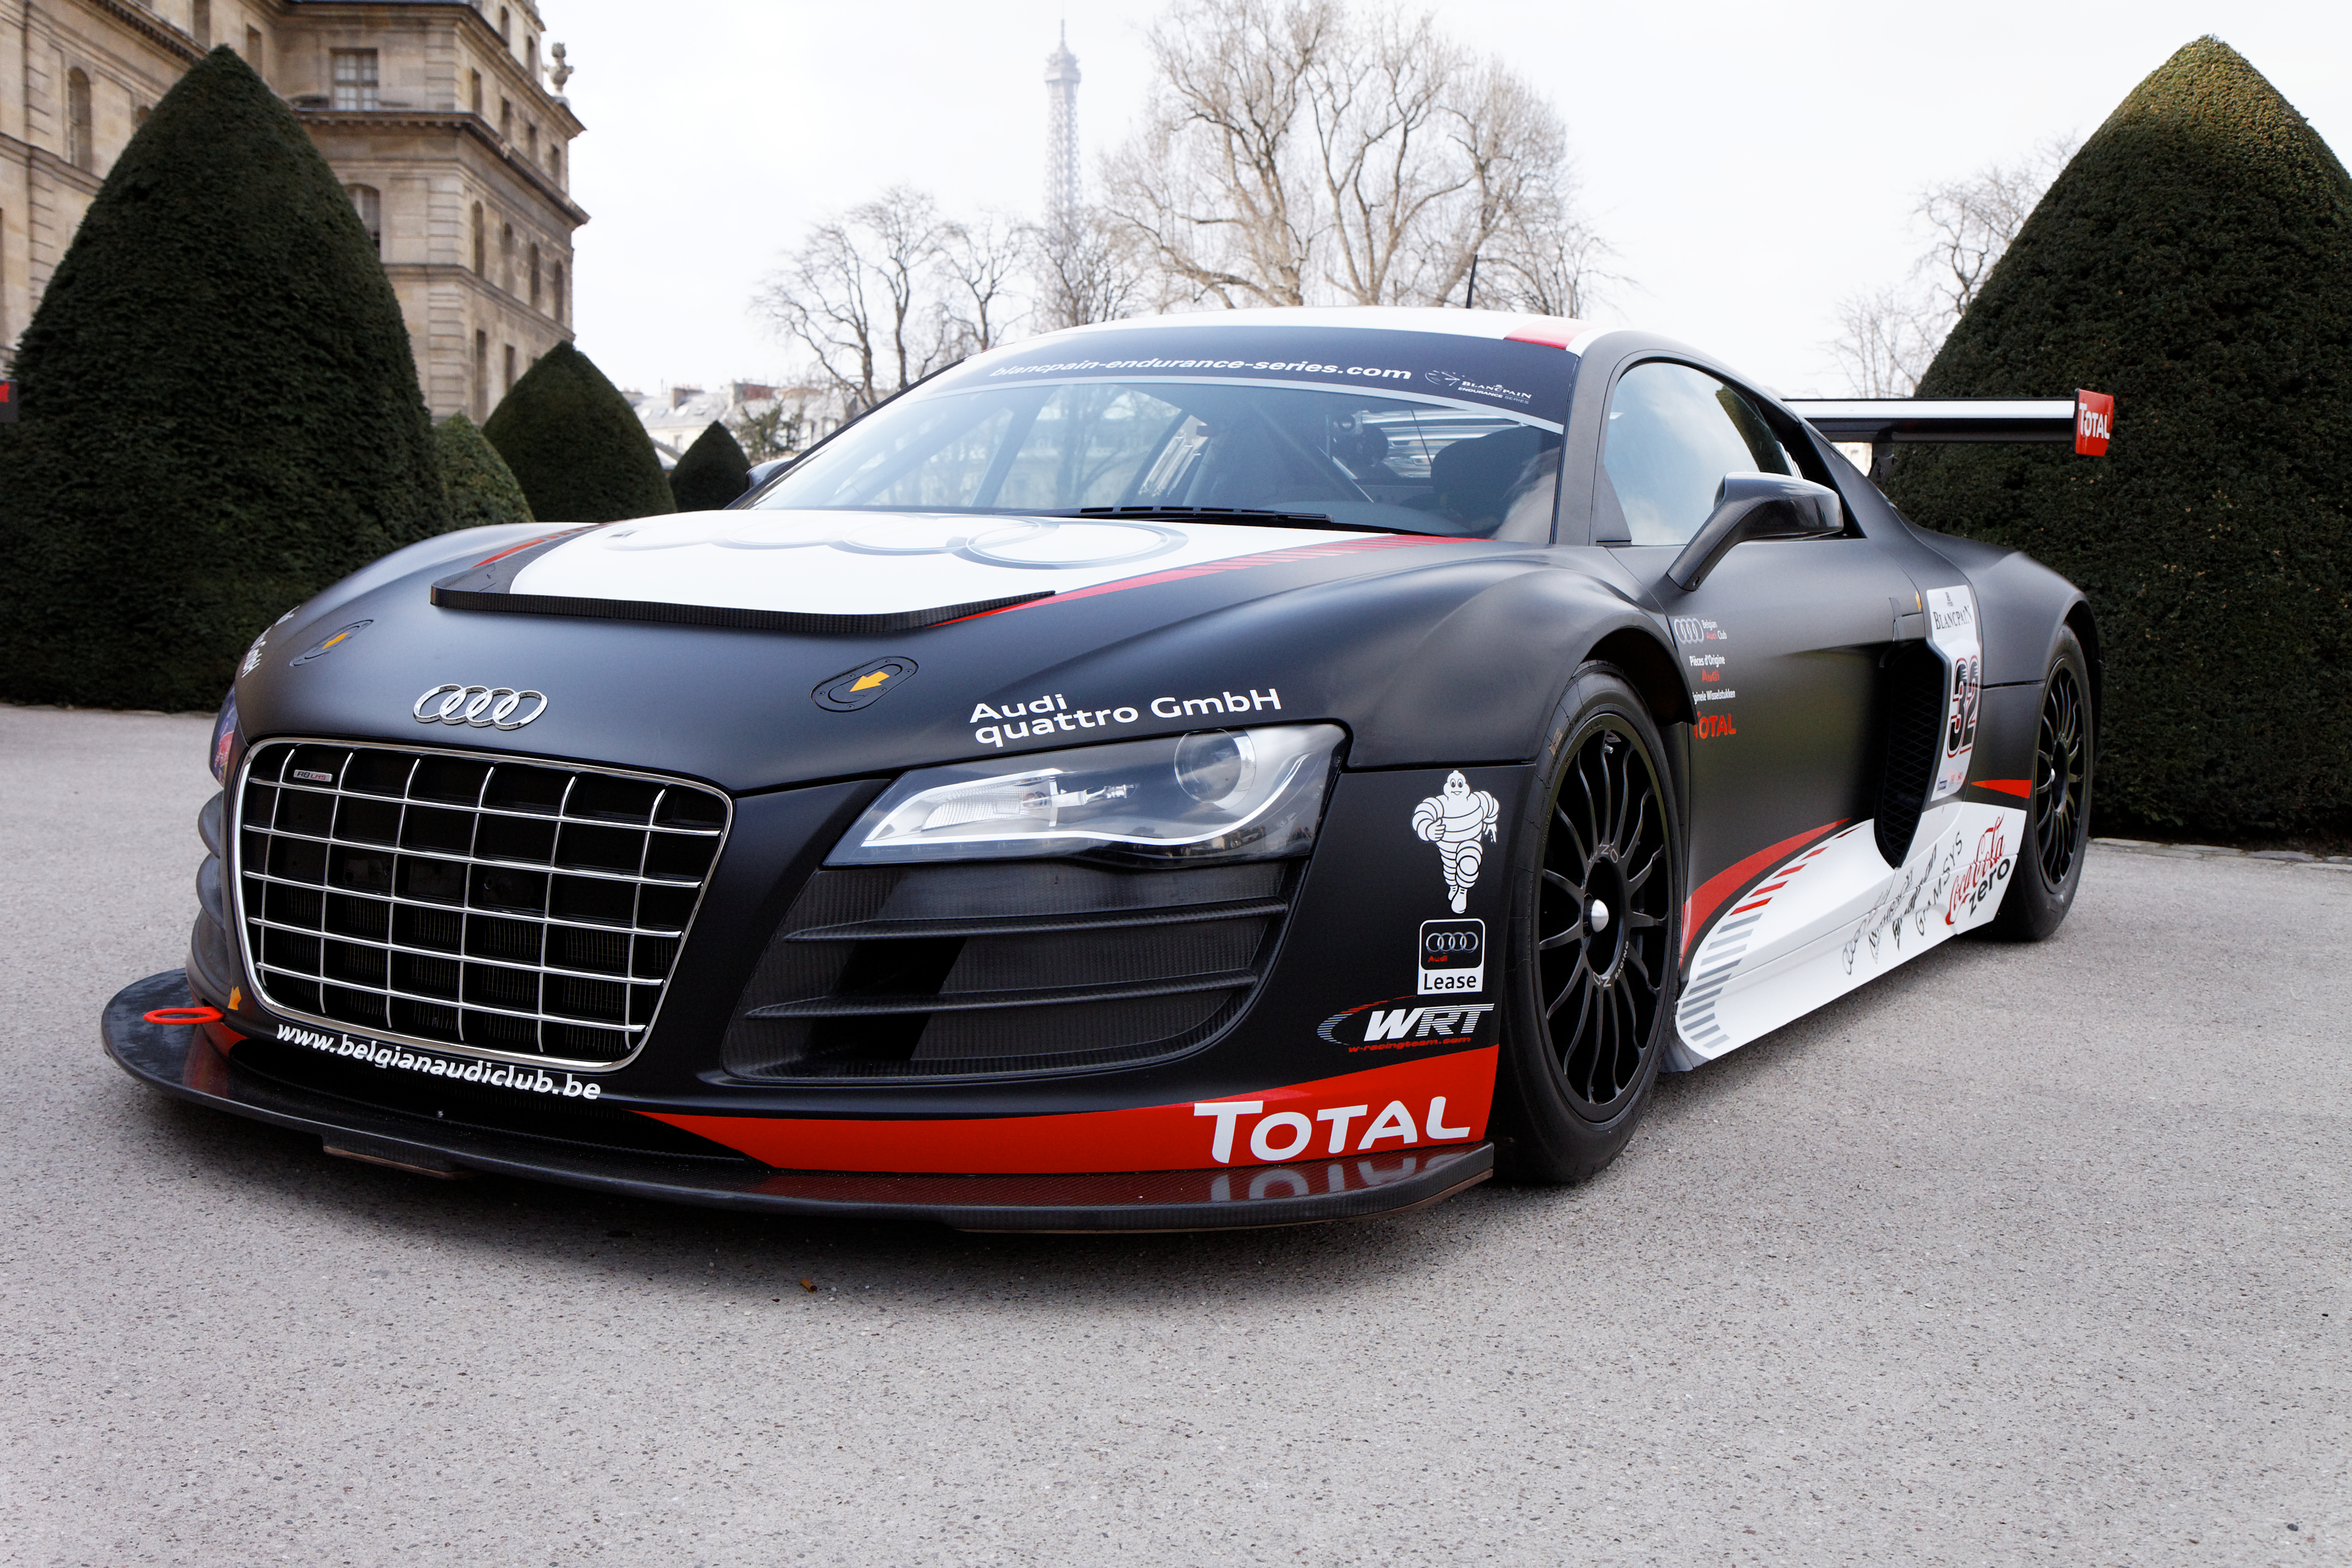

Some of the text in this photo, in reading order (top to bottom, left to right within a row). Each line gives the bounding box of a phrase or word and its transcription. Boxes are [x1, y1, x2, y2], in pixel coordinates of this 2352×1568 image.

[989, 357, 1412, 380] blancpain-endurance-series.com
[1458, 387, 1530, 404] ENDURANCE SERIES
[1461, 381, 1532, 399] BLANCPAIN
[2079, 402, 2110, 440] TOTAL
[1933, 605, 1973, 630] BLANCPAIN
[1702, 668, 1720, 682] Audi
[969, 693, 1068, 724] Audi
[975, 688, 1282, 748] quattro GmbH
[1947, 655, 1979, 758] 32
[1969, 858, 2010, 919] zero
[1615, 940, 1629, 980] RACING
[1423, 973, 1476, 990] Lease
[1364, 1003, 1495, 1042] WRT
[276, 1023, 601, 1100] www.belgianaudiclub.be
[1348, 1037, 1471, 1053] w-racingteam.com
[1194, 1096, 1471, 1164] TOTAL
